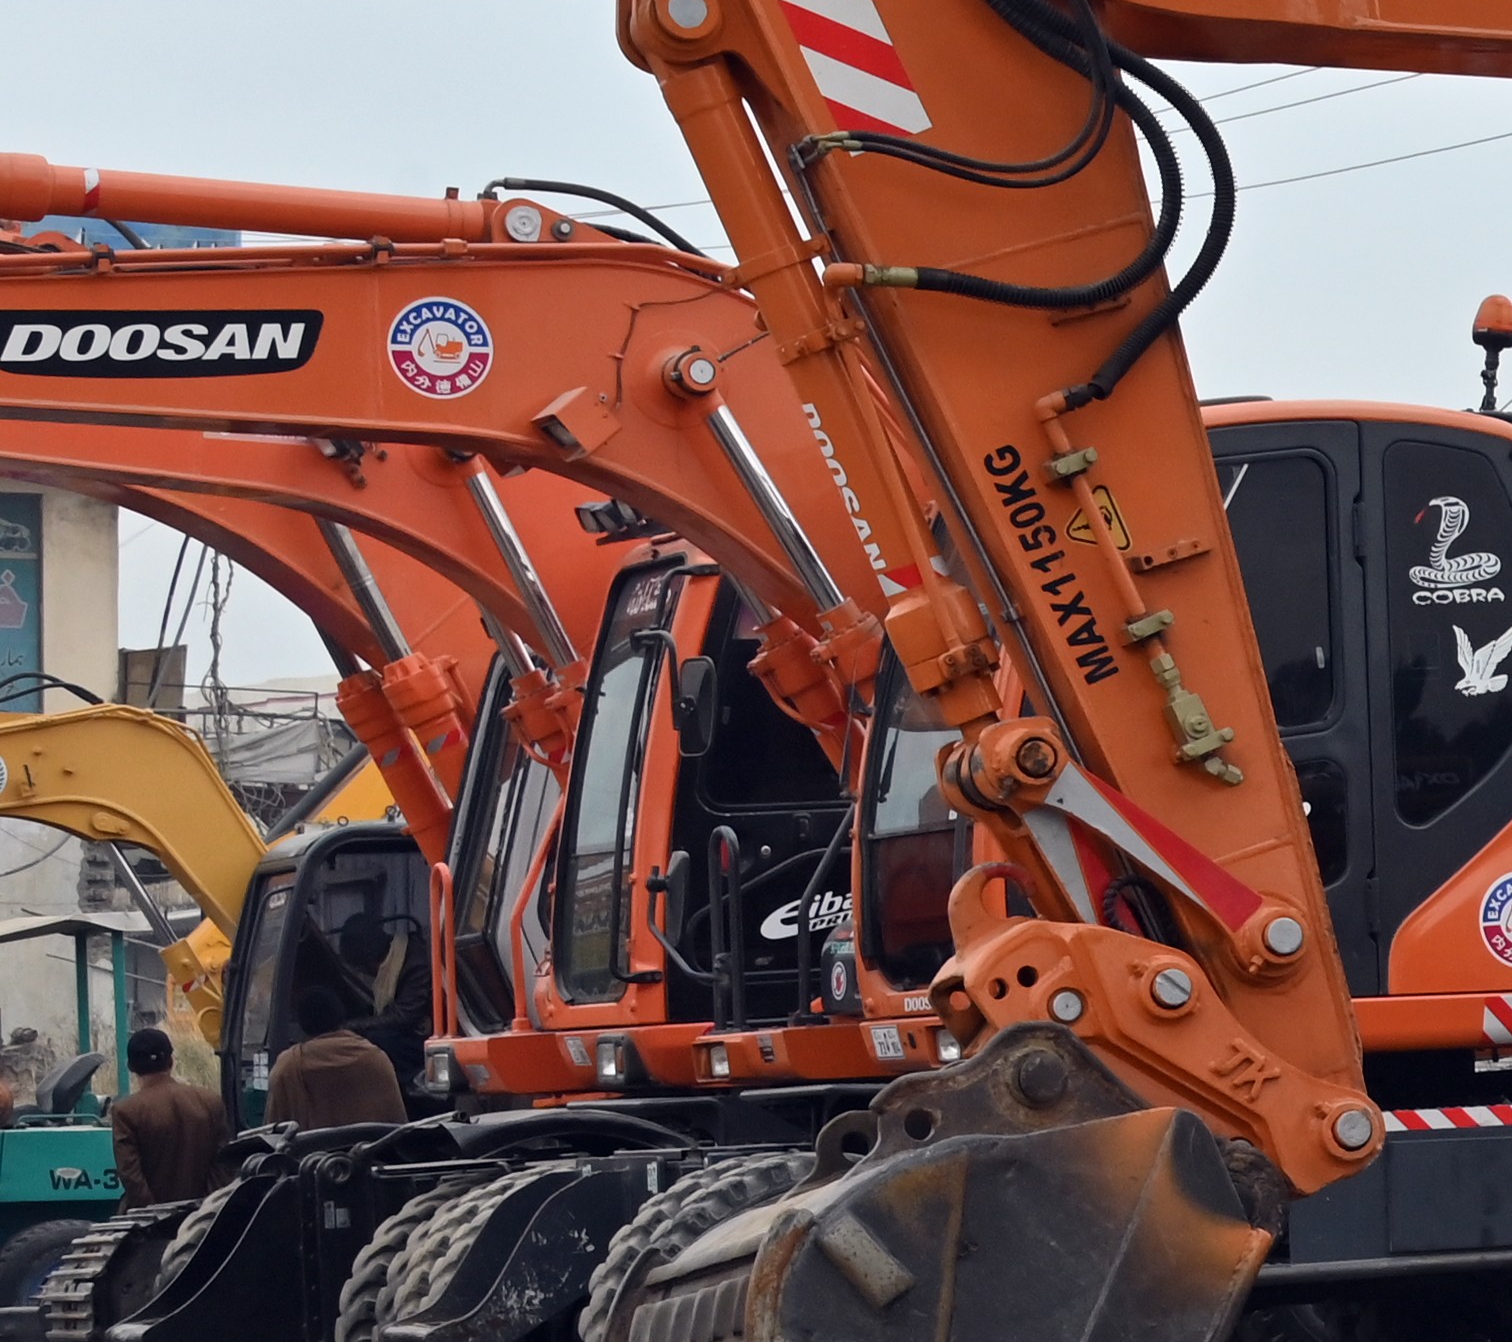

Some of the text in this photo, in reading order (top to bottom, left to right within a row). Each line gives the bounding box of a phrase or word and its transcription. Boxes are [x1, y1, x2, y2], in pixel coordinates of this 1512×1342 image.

[0, 323, 305, 361] DOOSAN
[396, 305, 484, 346] EXCAVATOR
[1412, 587, 1505, 605] COBRA
